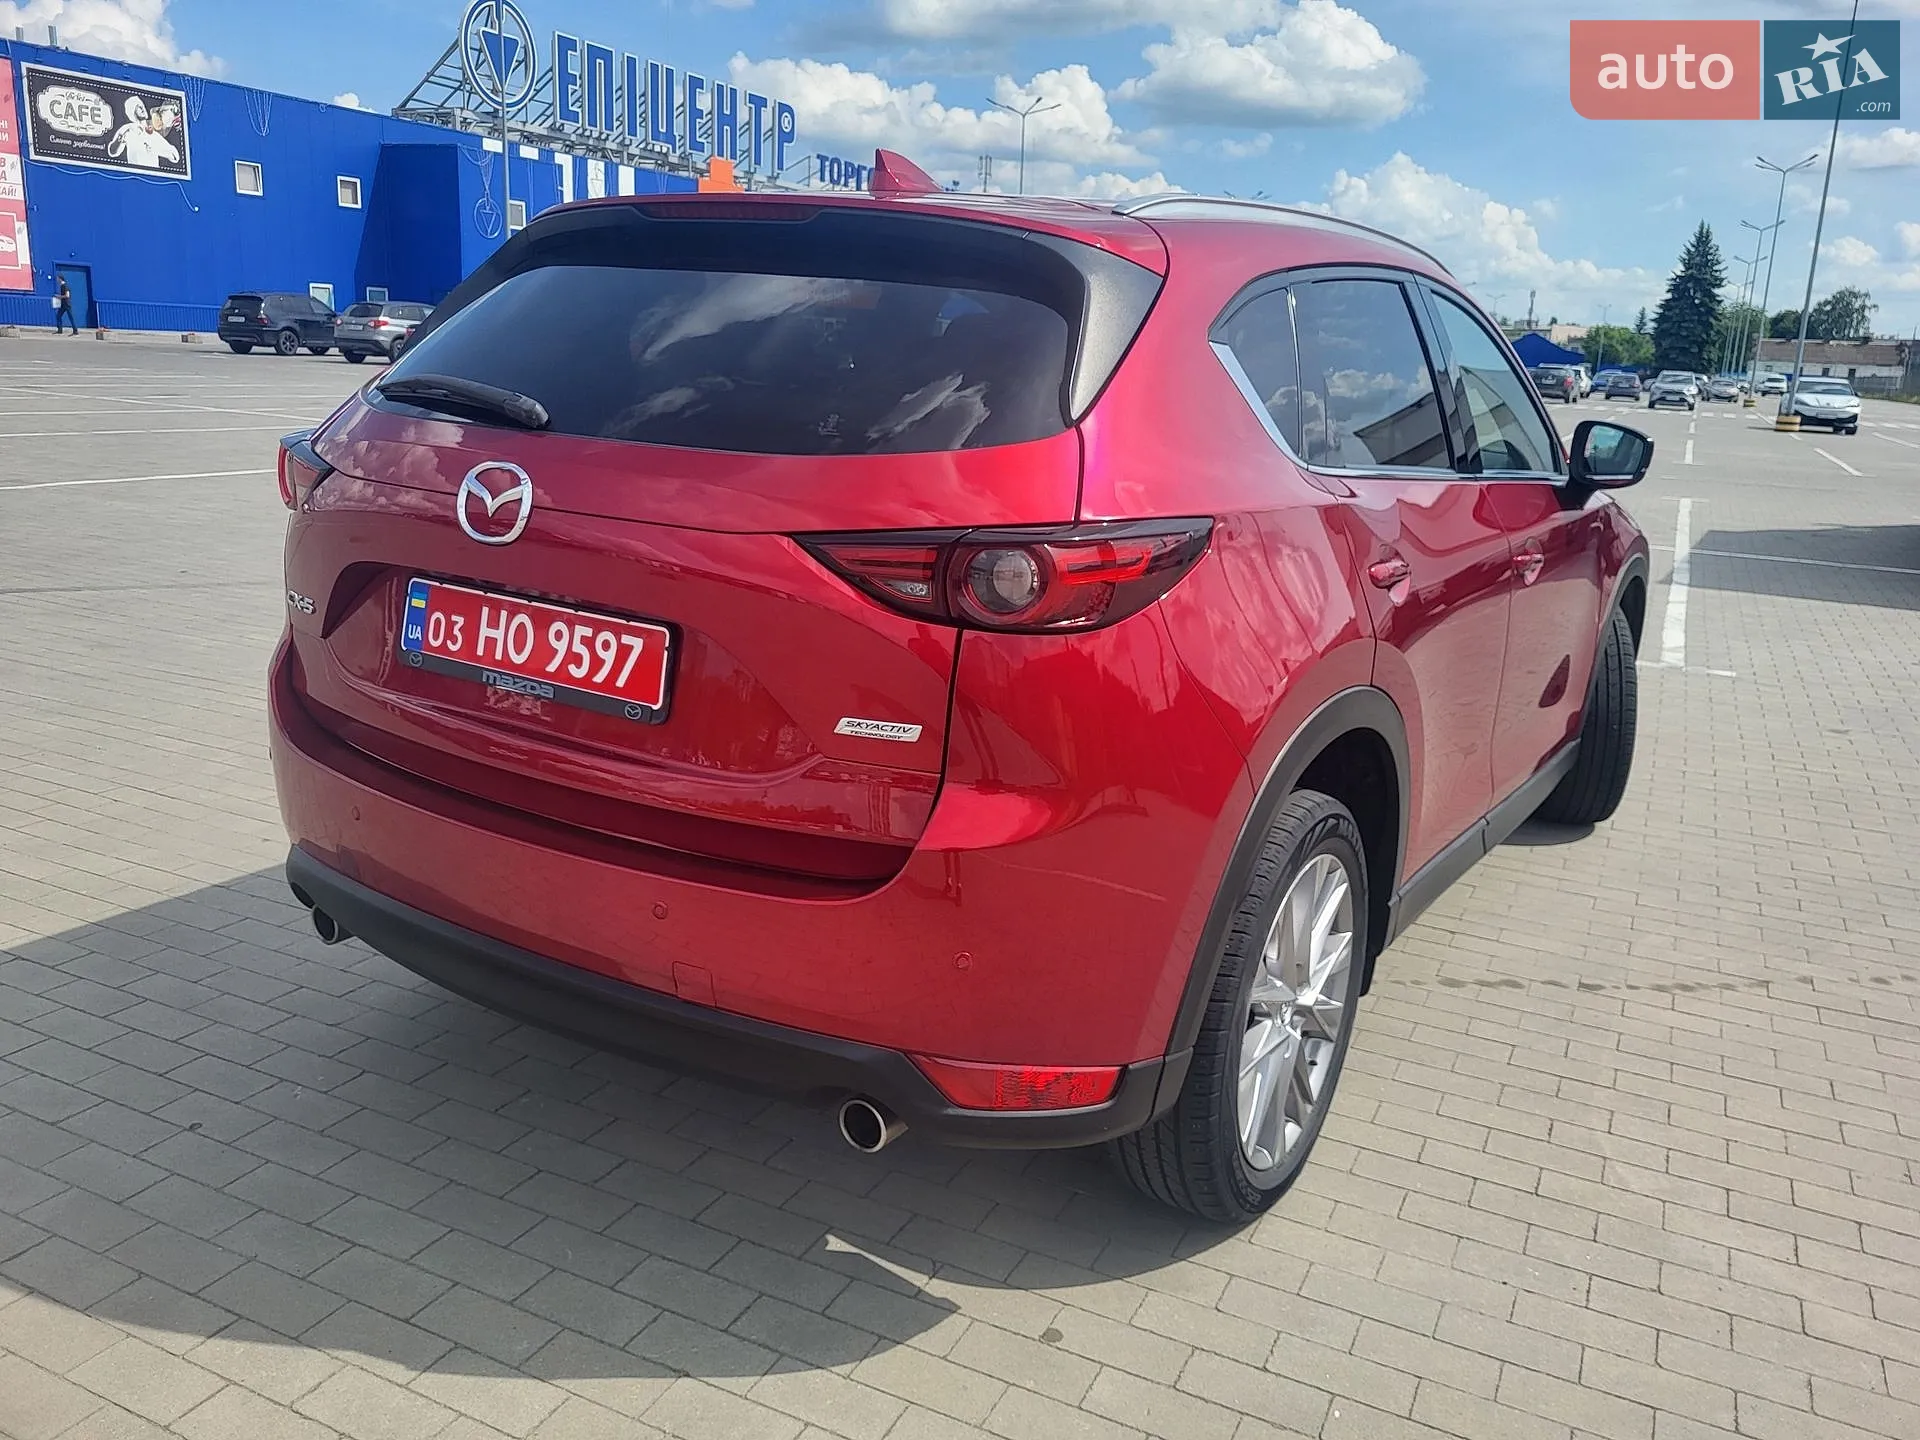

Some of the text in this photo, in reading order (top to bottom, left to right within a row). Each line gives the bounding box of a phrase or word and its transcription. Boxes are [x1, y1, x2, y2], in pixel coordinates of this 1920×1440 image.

[553, 30, 797, 172] ЕПІЦЕНТР
[407, 623, 422, 641] UA
[427, 605, 644, 688] 03 HO 9597
[844, 720, 913, 733] SKYACTIV
[849, 730, 904, 740] TECHNOLOGY
